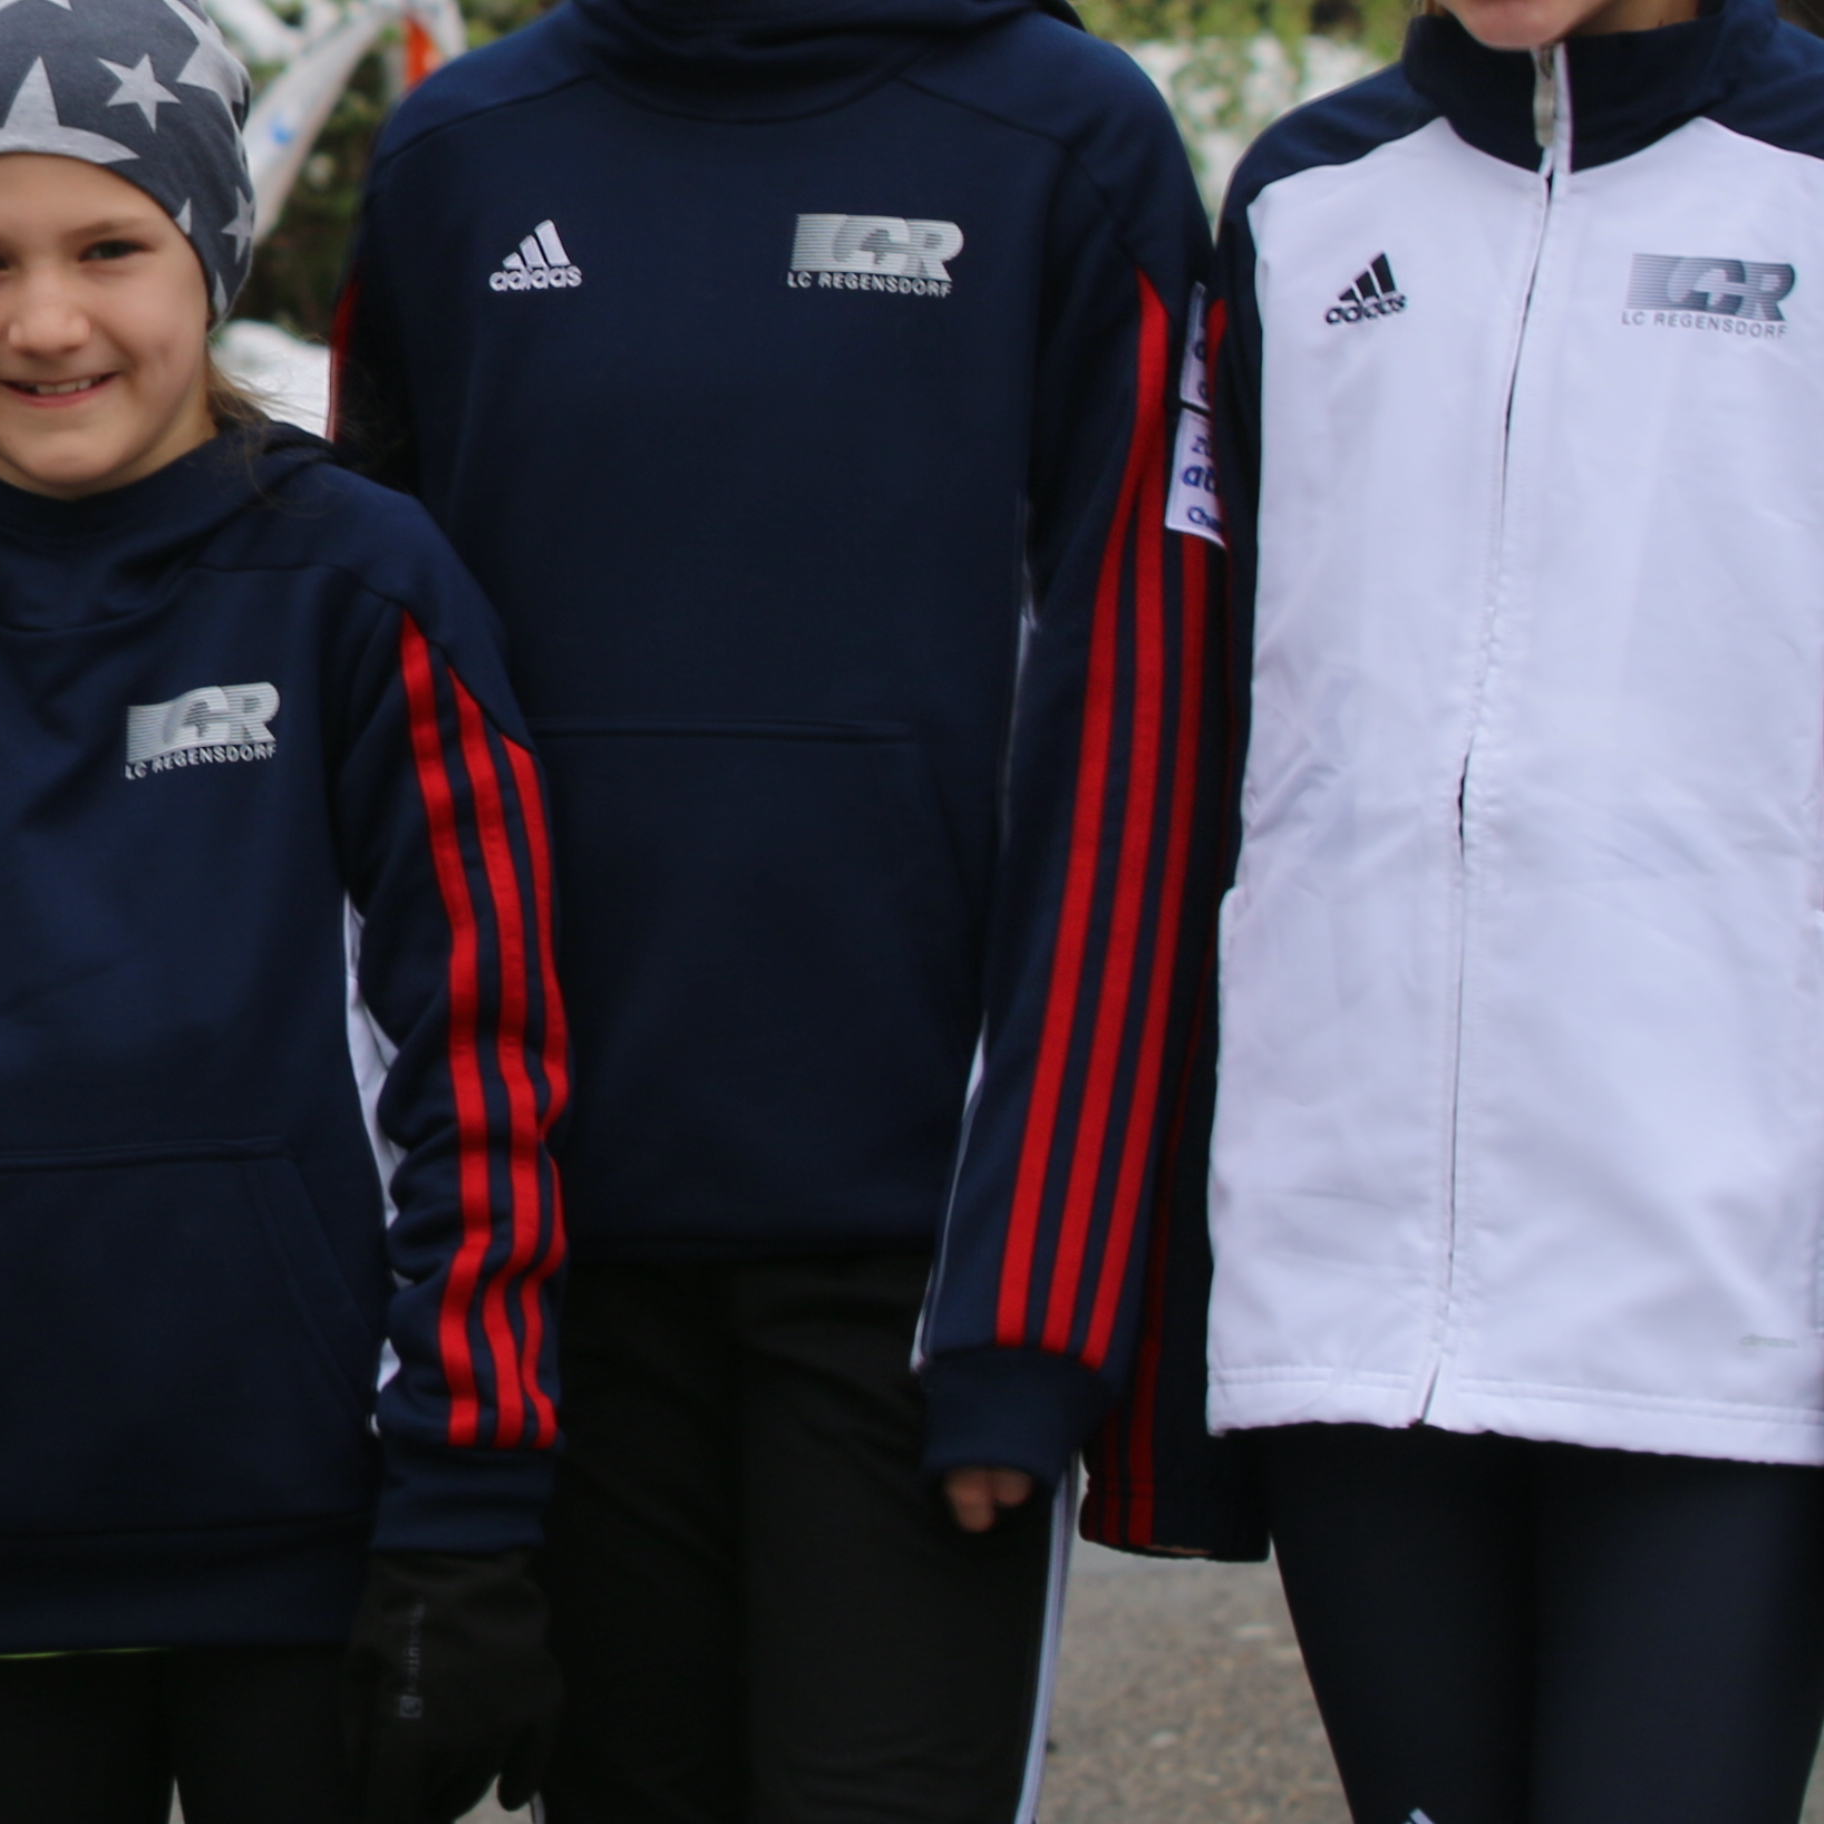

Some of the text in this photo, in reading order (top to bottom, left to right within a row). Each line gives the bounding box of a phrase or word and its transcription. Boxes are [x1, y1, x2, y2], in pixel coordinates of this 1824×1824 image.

[489, 265, 582, 291] adidas
[787, 272, 953, 298] LC REGENSDORF
[1324, 292, 1407, 325] adidas
[1621, 311, 1787, 340] LC REGENSDORF
[125, 741, 277, 780] LC REGENSDORF
